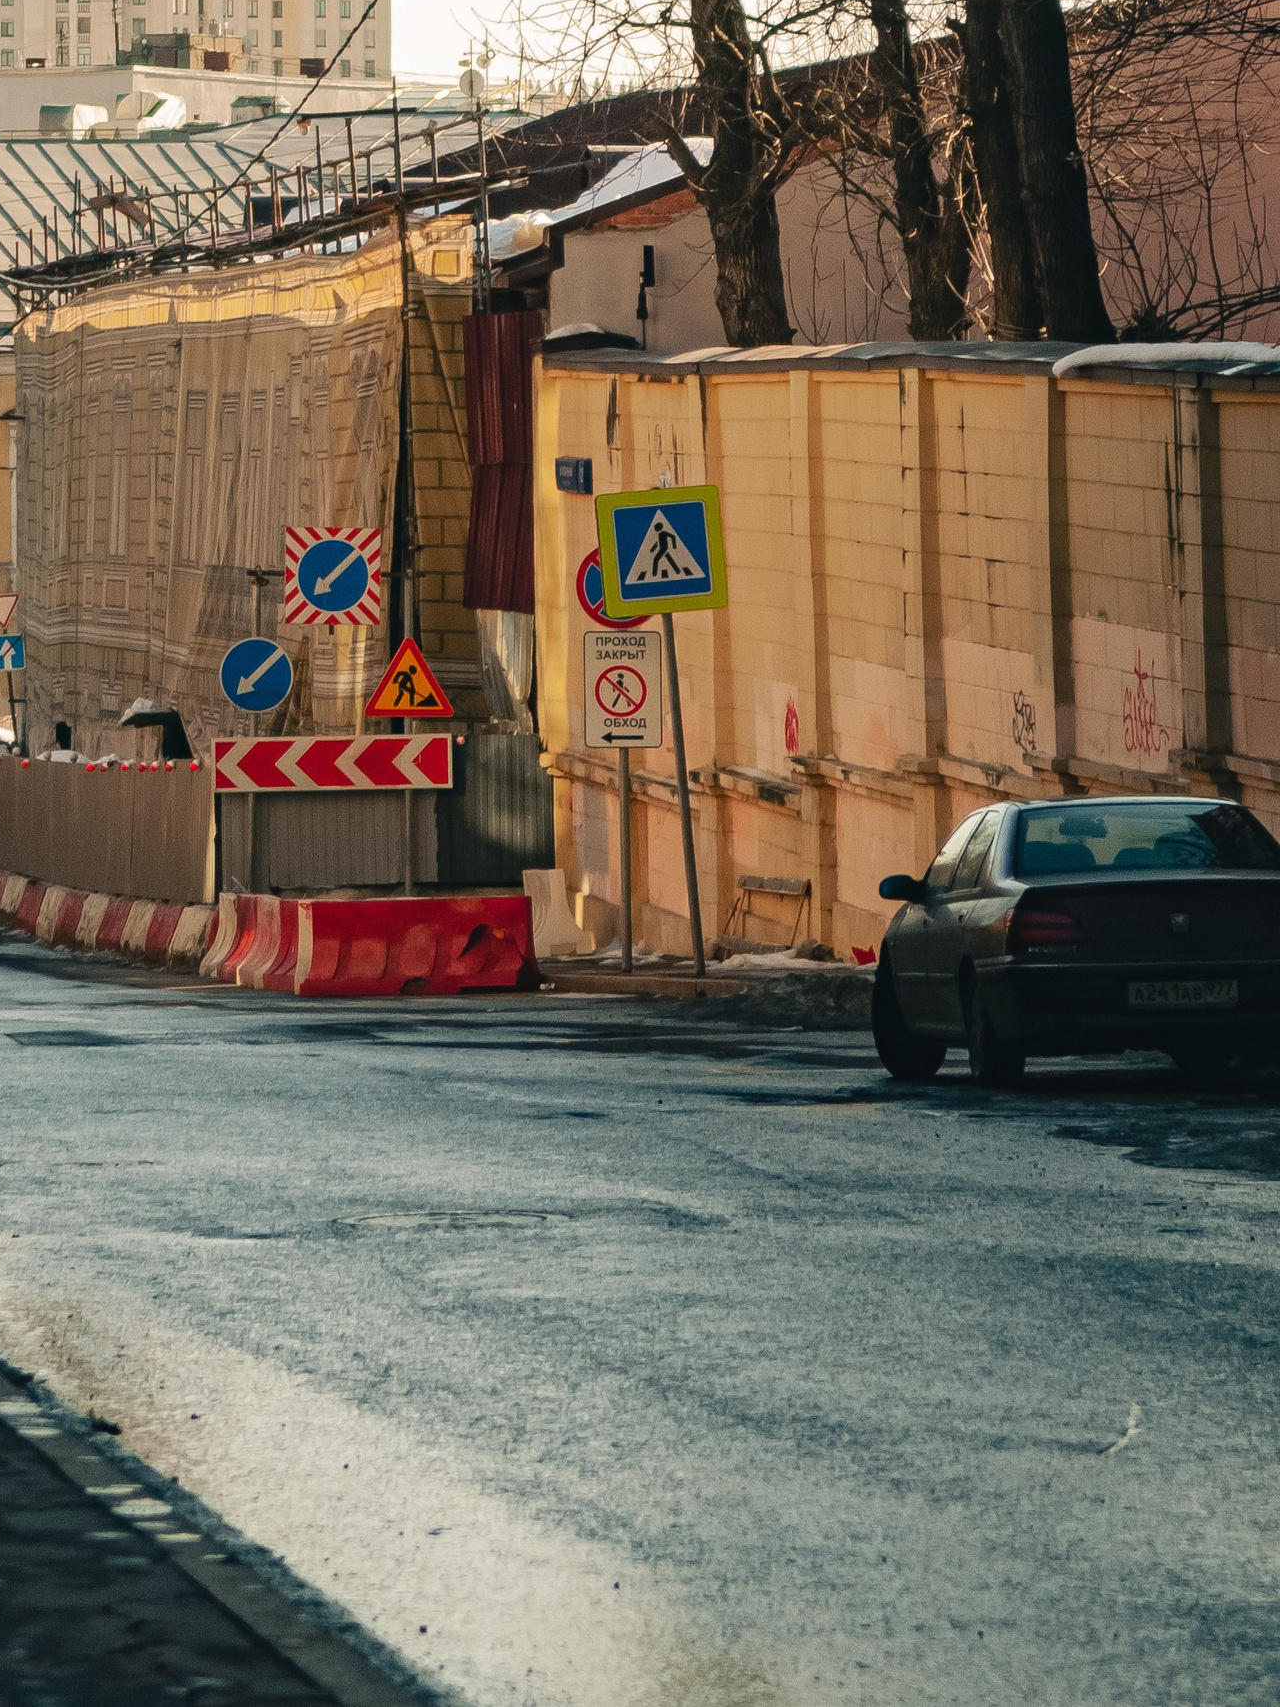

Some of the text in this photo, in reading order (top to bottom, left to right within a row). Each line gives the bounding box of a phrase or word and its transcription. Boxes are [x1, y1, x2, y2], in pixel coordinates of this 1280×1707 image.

[595, 636, 647, 647] ПРОХОД
[595, 650, 646, 660] ЗАКРЫТ
[603, 717, 647, 729] ОБХОД
